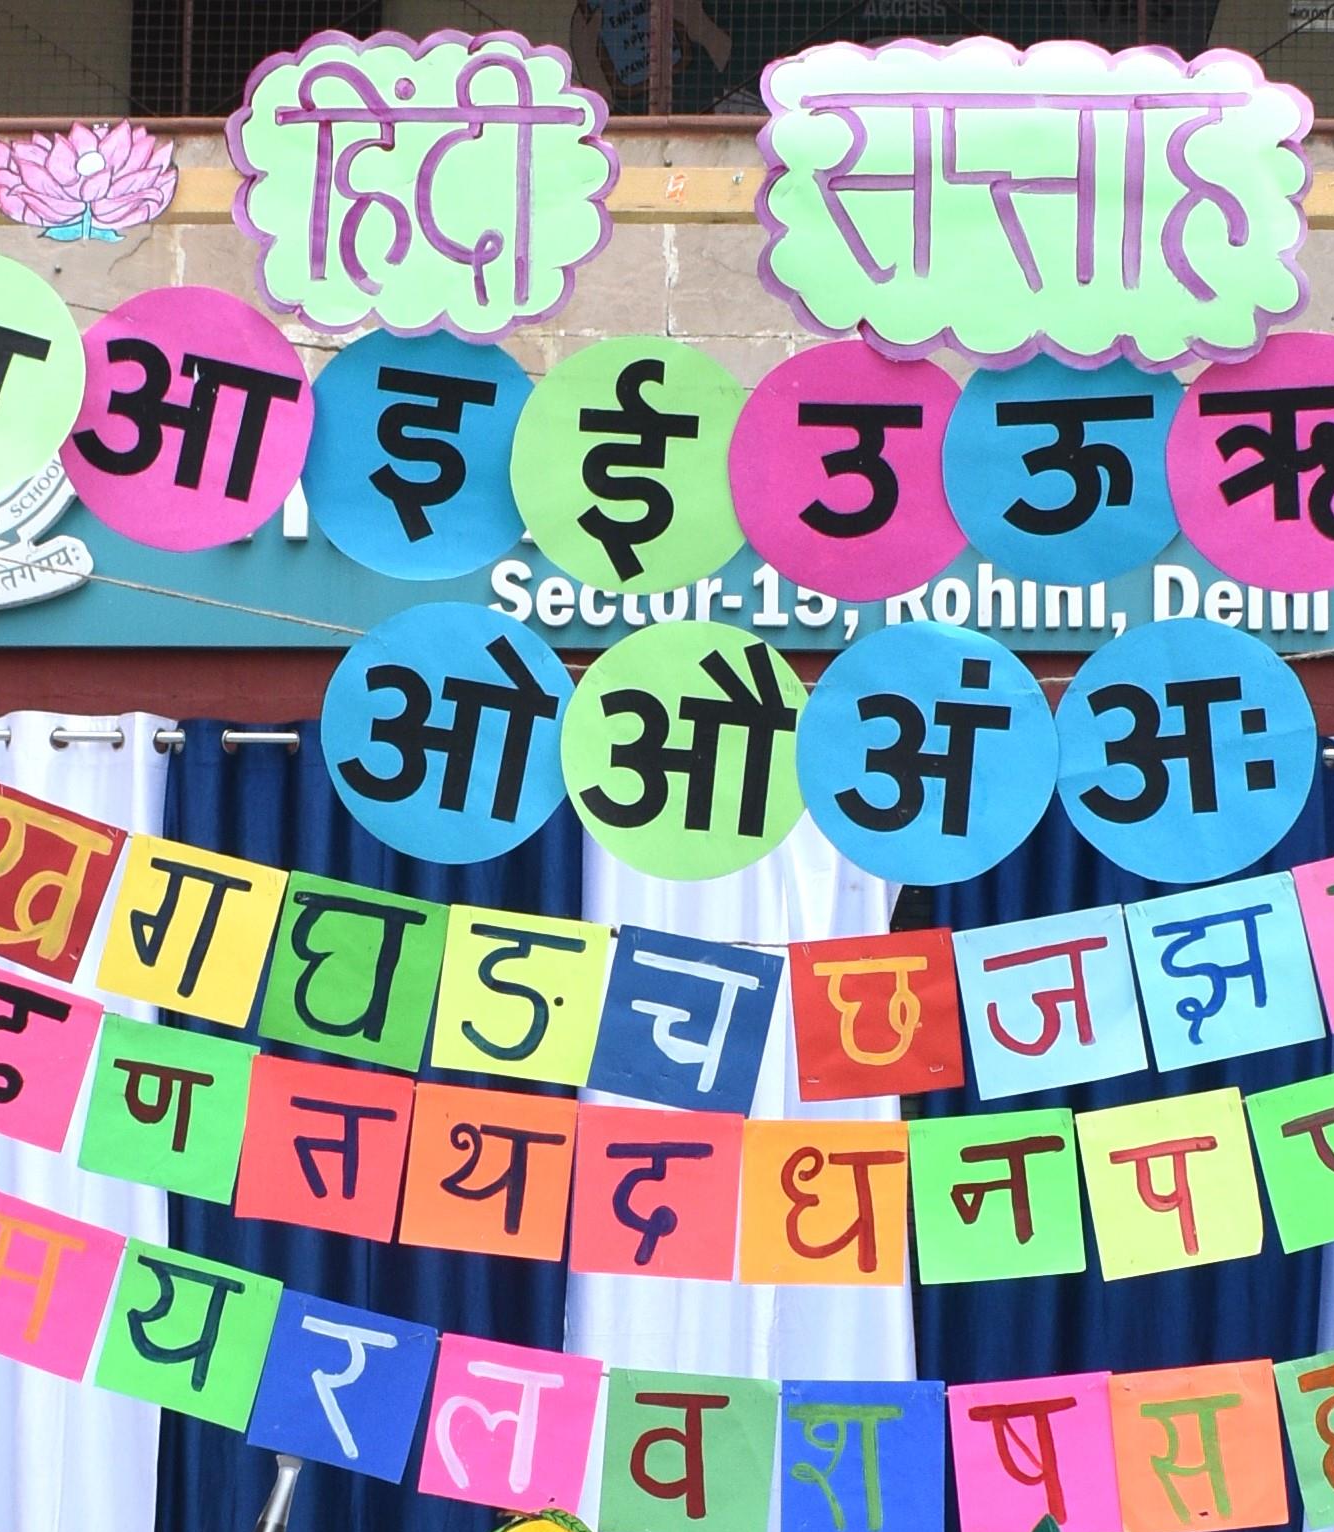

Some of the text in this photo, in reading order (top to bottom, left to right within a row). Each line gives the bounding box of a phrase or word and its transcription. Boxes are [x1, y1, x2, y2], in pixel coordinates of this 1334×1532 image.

[275, 54, 1251, 306] हिंदी सप्ताह
[73, 338, 307, 503] आ
[369, 366, 497, 543] इ
[578, 359, 699, 582] ई
[798, 403, 923, 540] उ
[994, 395, 1153, 537] ऊ
[337, 635, 1277, 838] ओ औ अं अः
[129, 856, 252, 998] ग
[292, 890, 427, 1042] घ
[462, 923, 586, 1062] ङ
[631, 949, 765, 1093] च
[813, 955, 928, 1067] छ
[983, 937, 1108, 1056] ज
[1152, 903, 1273, 1047] झ
[114, 1057, 214, 1153] ण
[290, 1096, 398, 1200] त
[440, 1122, 566, 1236] थ
[606, 1142, 714, 1266] द
[781, 1146, 906, 1273] ध
[951, 1135, 1066, 1244] न
[1109, 1136, 1218, 1256] प
[127, 1255, 246, 1392] य
[302, 1314, 398, 1460] र
[435, 1360, 564, 1493] ल
[629, 1391, 730, 1520] व
[967, 1396, 1077, 1525] ष
[1140, 1393, 1242, 1525] स
